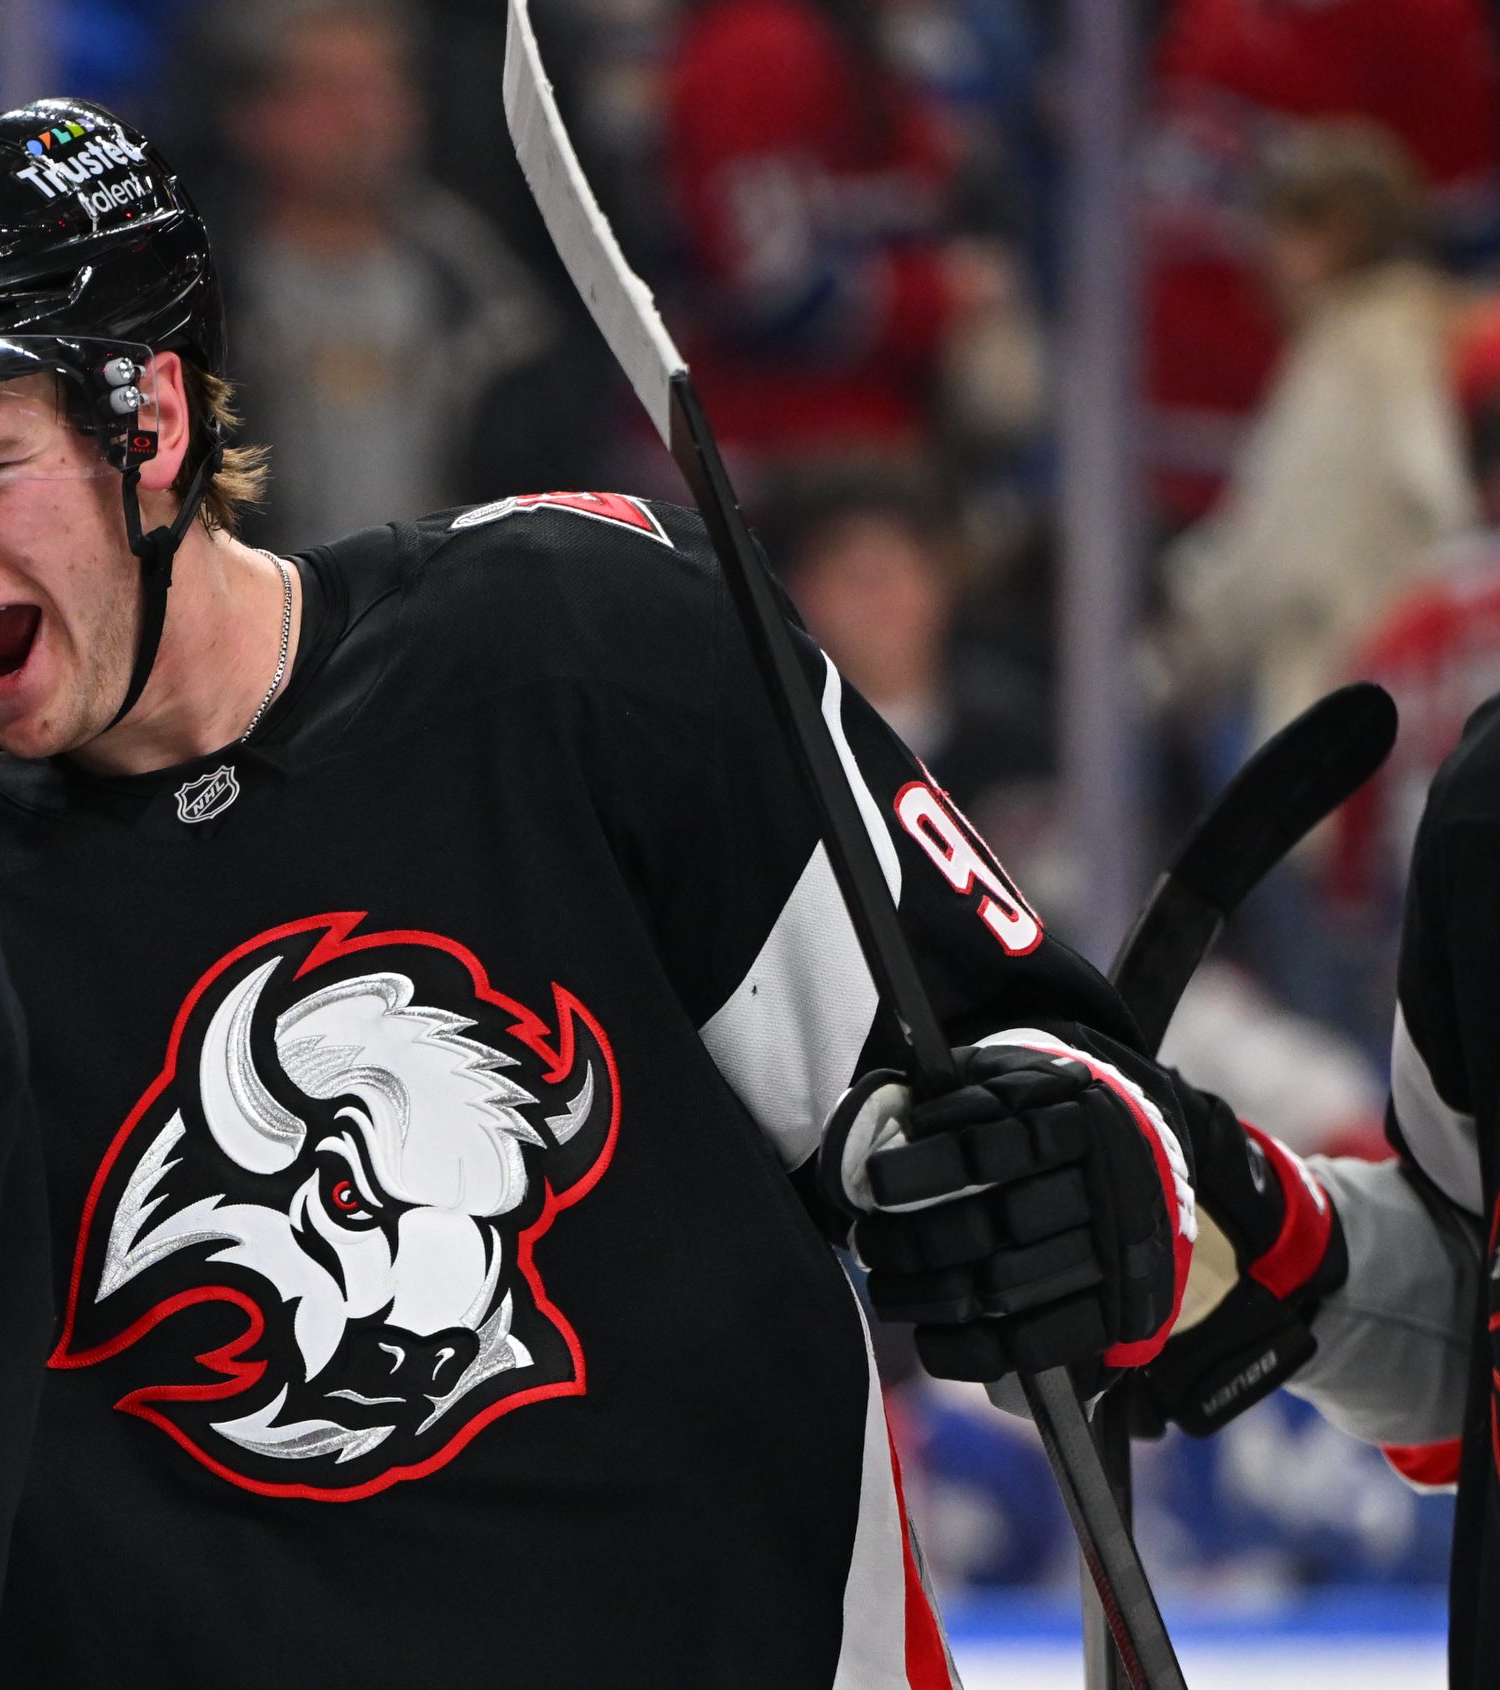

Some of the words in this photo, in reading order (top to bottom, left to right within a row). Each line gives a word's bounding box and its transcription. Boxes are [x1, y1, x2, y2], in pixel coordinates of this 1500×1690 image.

[16, 123, 147, 198] Trusted
[77, 171, 146, 217] talent
[193, 781, 225, 815] NHL
[893, 756, 1044, 957] 9
